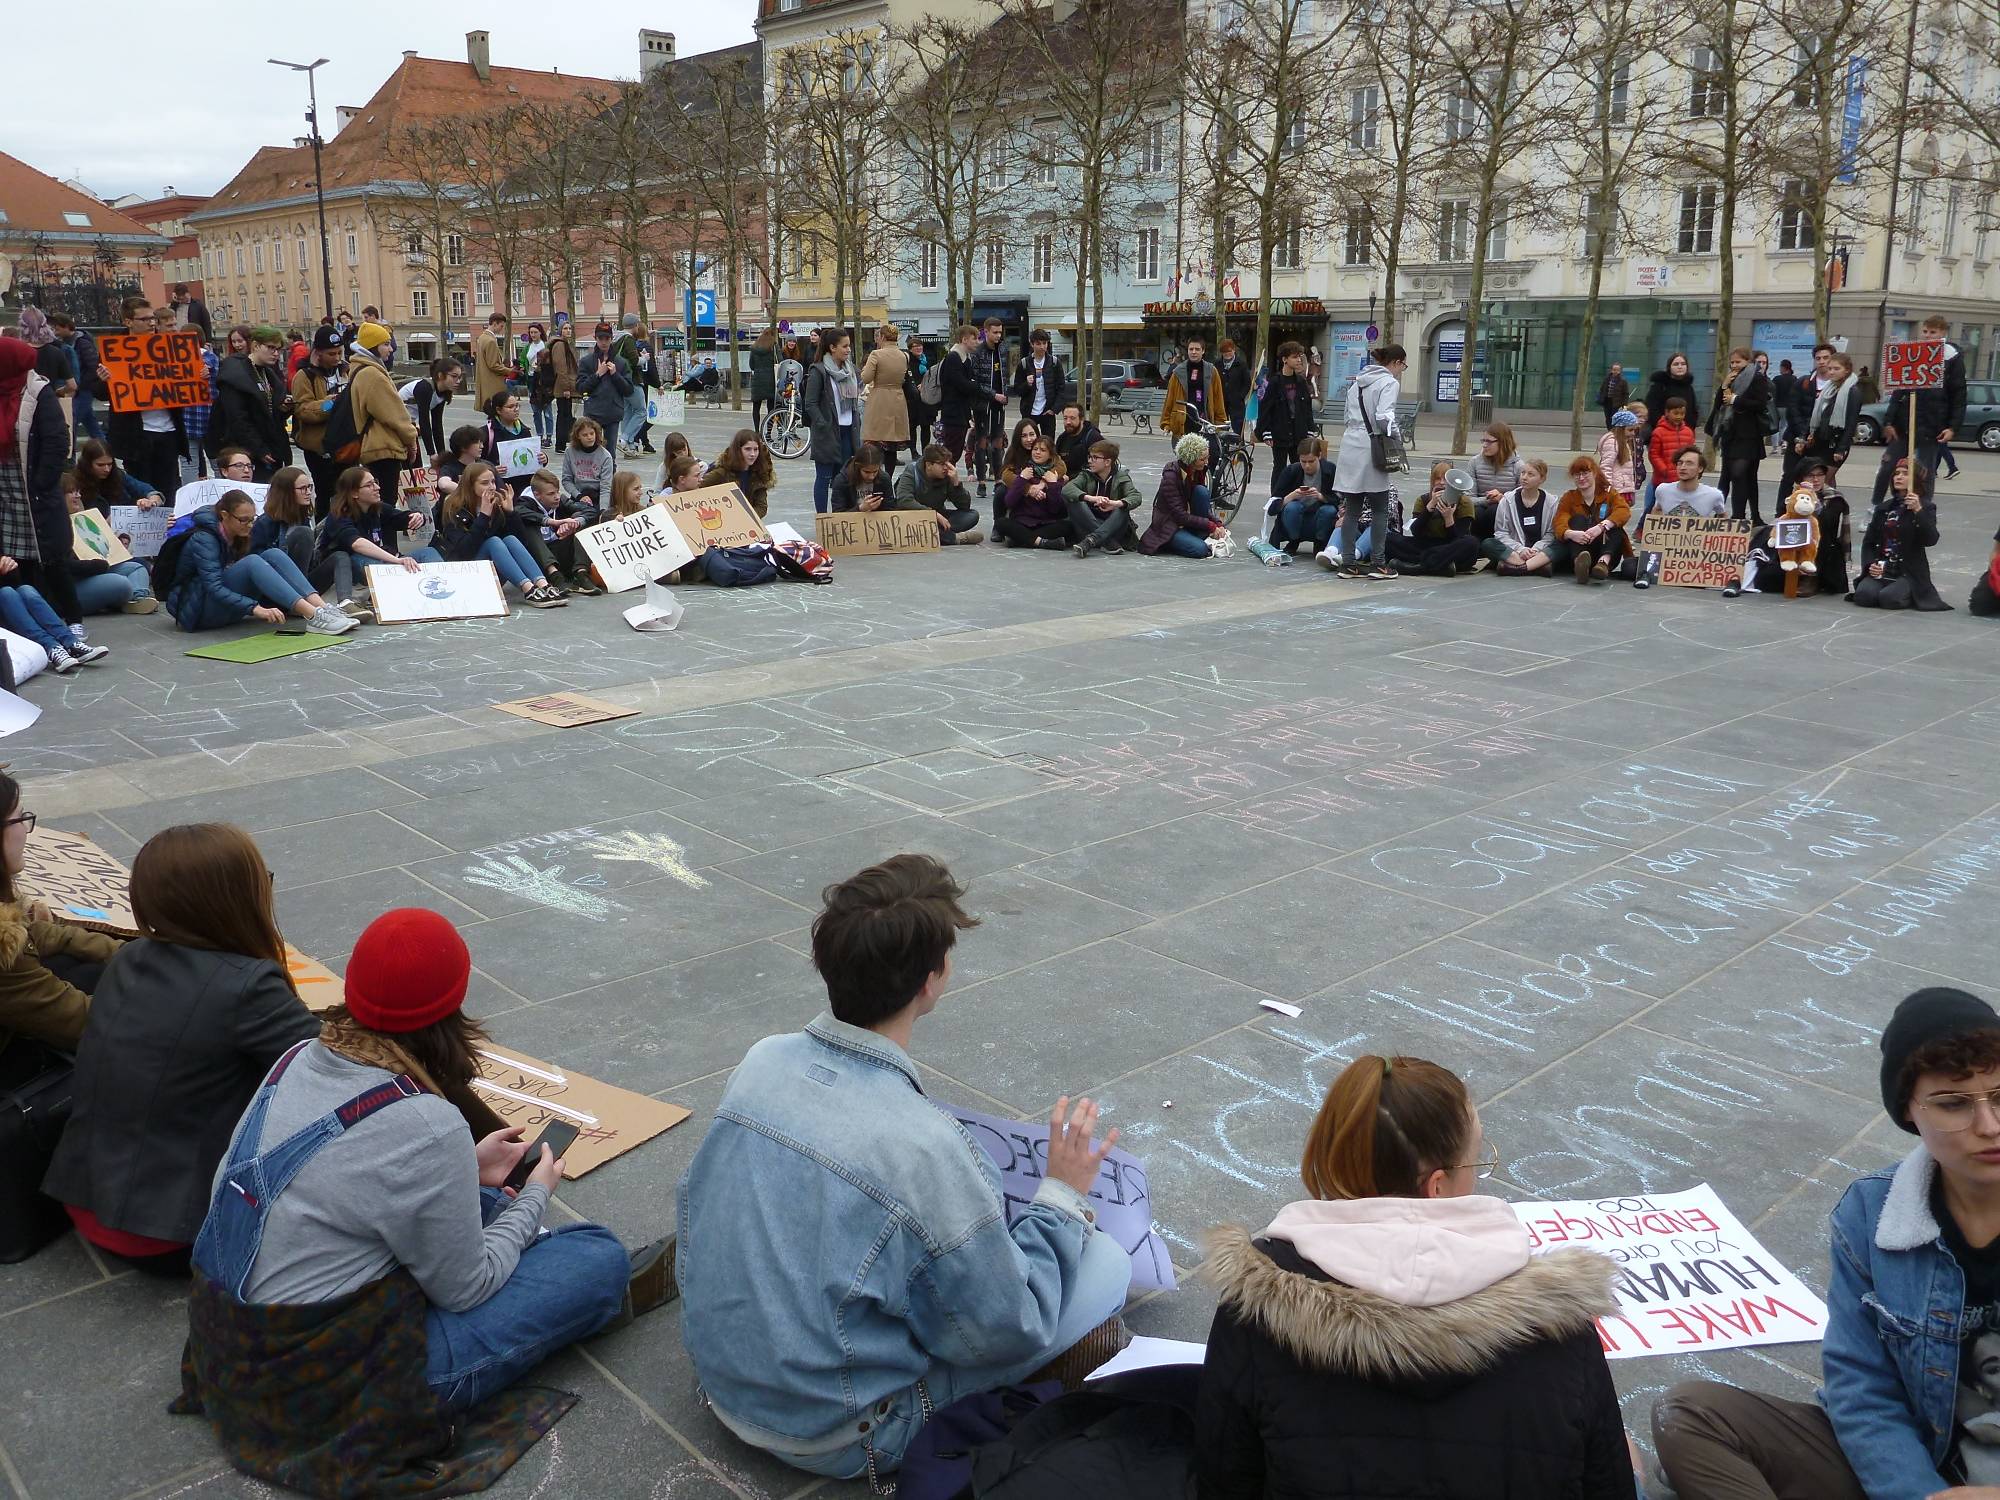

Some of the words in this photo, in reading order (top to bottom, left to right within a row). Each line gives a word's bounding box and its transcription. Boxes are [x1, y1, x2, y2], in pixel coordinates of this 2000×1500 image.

[102, 336, 141, 362] ES
[147, 335, 200, 363] GIBT
[1888, 345, 1941, 363] BUY
[1887, 364, 1942, 385] LESS
[113, 381, 197, 409] PLANET
[112, 508, 133, 519] THE
[138, 507, 169, 519] PLANE
[665, 496, 732, 513] Warning
[115, 521, 123, 531] IS
[127, 522, 168, 532] GETTING
[592, 526, 616, 546] IT'S
[623, 514, 656, 538] OUR
[816, 516, 858, 550] THERE
[863, 518, 876, 545] IS
[876, 520, 890, 544] NO
[891, 514, 928, 548] PLANET
[930, 521, 940, 549] B
[1646, 517, 1682, 531] THIS
[1686, 518, 1736, 533] PLANET
[1737, 519, 1752, 533] IS
[602, 529, 669, 569] FUTURE
[1644, 533, 1702, 547] GETTING
[1703, 534, 1747, 553] HOTTER
[1664, 548, 1699, 559] THAN
[1701, 550, 1747, 566] YOUNG
[1664, 560, 1737, 575] LEONARDO
[616, 667, 1069, 752] STOP
[697, 665, 1307, 798] PLASTIK
[1345, 752, 1481, 790] SIND
[470, 826, 600, 860] FUTURE
[1573, 877, 1648, 910] von
[1630, 848, 1721, 874] den
[1624, 912, 1736, 944] &
[1767, 935, 1876, 977] der
[1367, 943, 1656, 1053] lieber
[508, 1074, 569, 1098] OUR
[1610, 1243, 1661, 1263] are
[1594, 1314, 1653, 1352] U
[1646, 1294, 1819, 1346] WAKE
